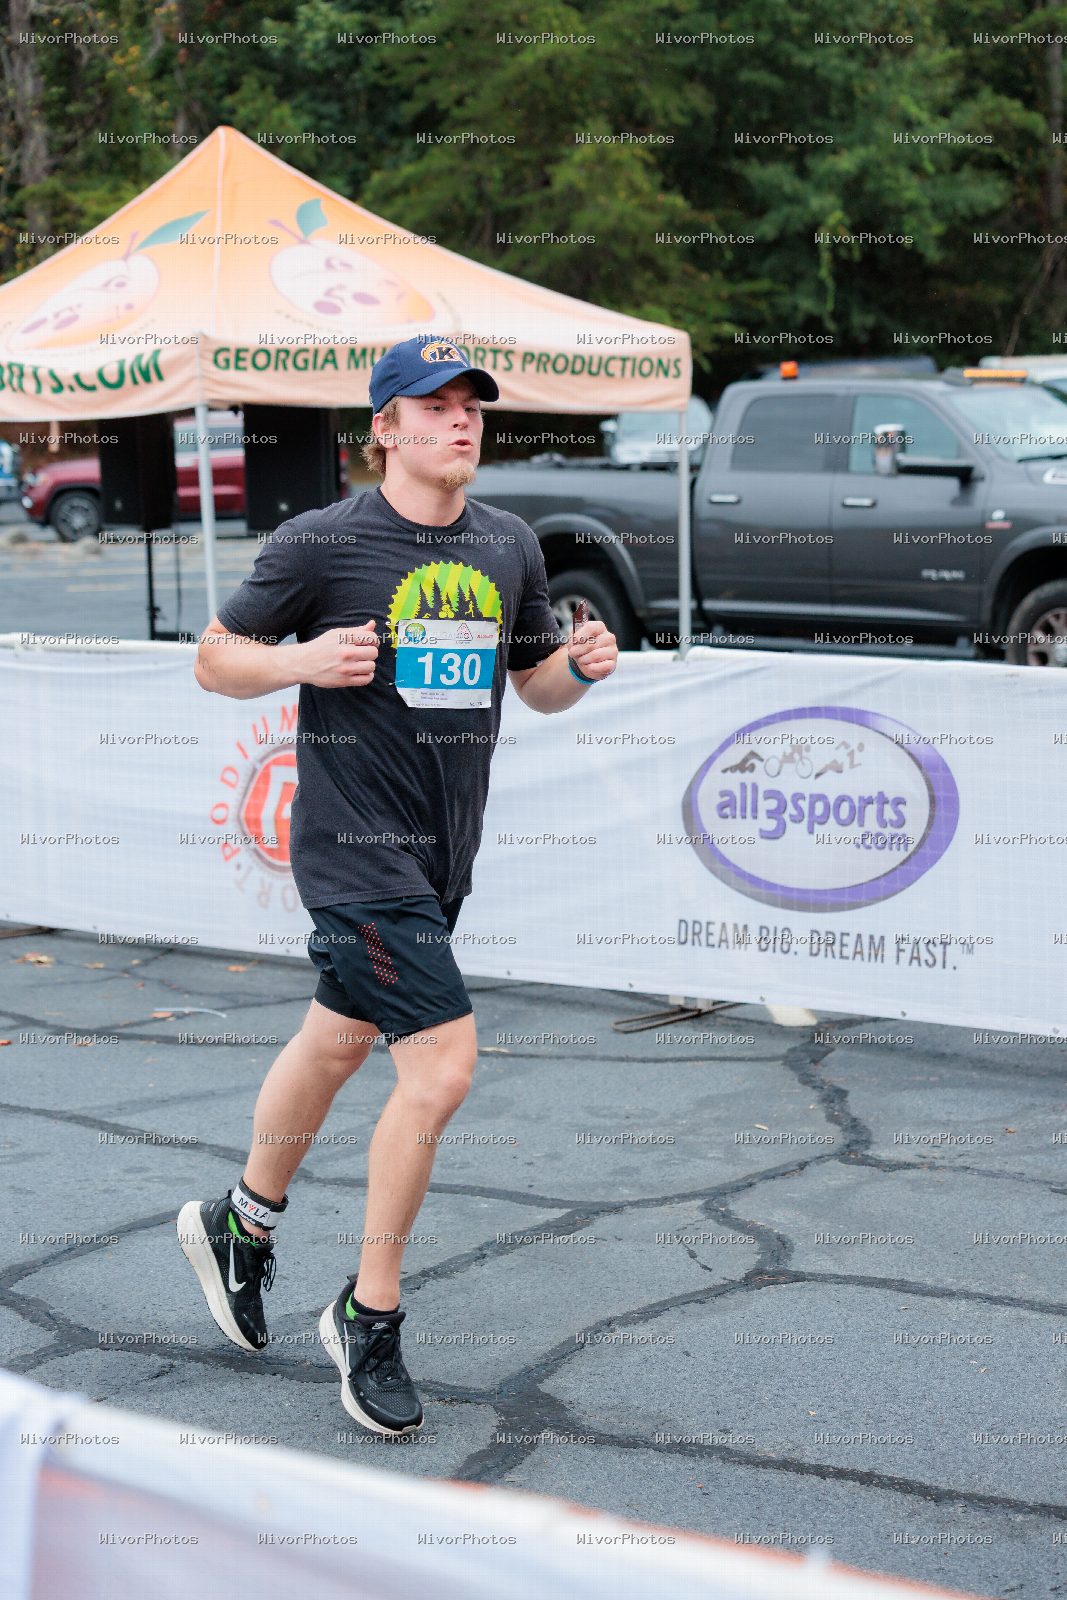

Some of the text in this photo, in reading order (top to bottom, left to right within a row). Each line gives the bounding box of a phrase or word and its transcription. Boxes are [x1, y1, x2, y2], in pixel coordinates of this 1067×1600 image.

[212, 346, 339, 371] GEORGIA
[521, 351, 682, 378] PRODUCTIONS
[417, 651, 482, 686] 130
[716, 782, 907, 840] all3sports
[677, 918, 748, 951] DREAM
[758, 924, 798, 956] BIG.
[809, 929, 885, 963] DREAM
